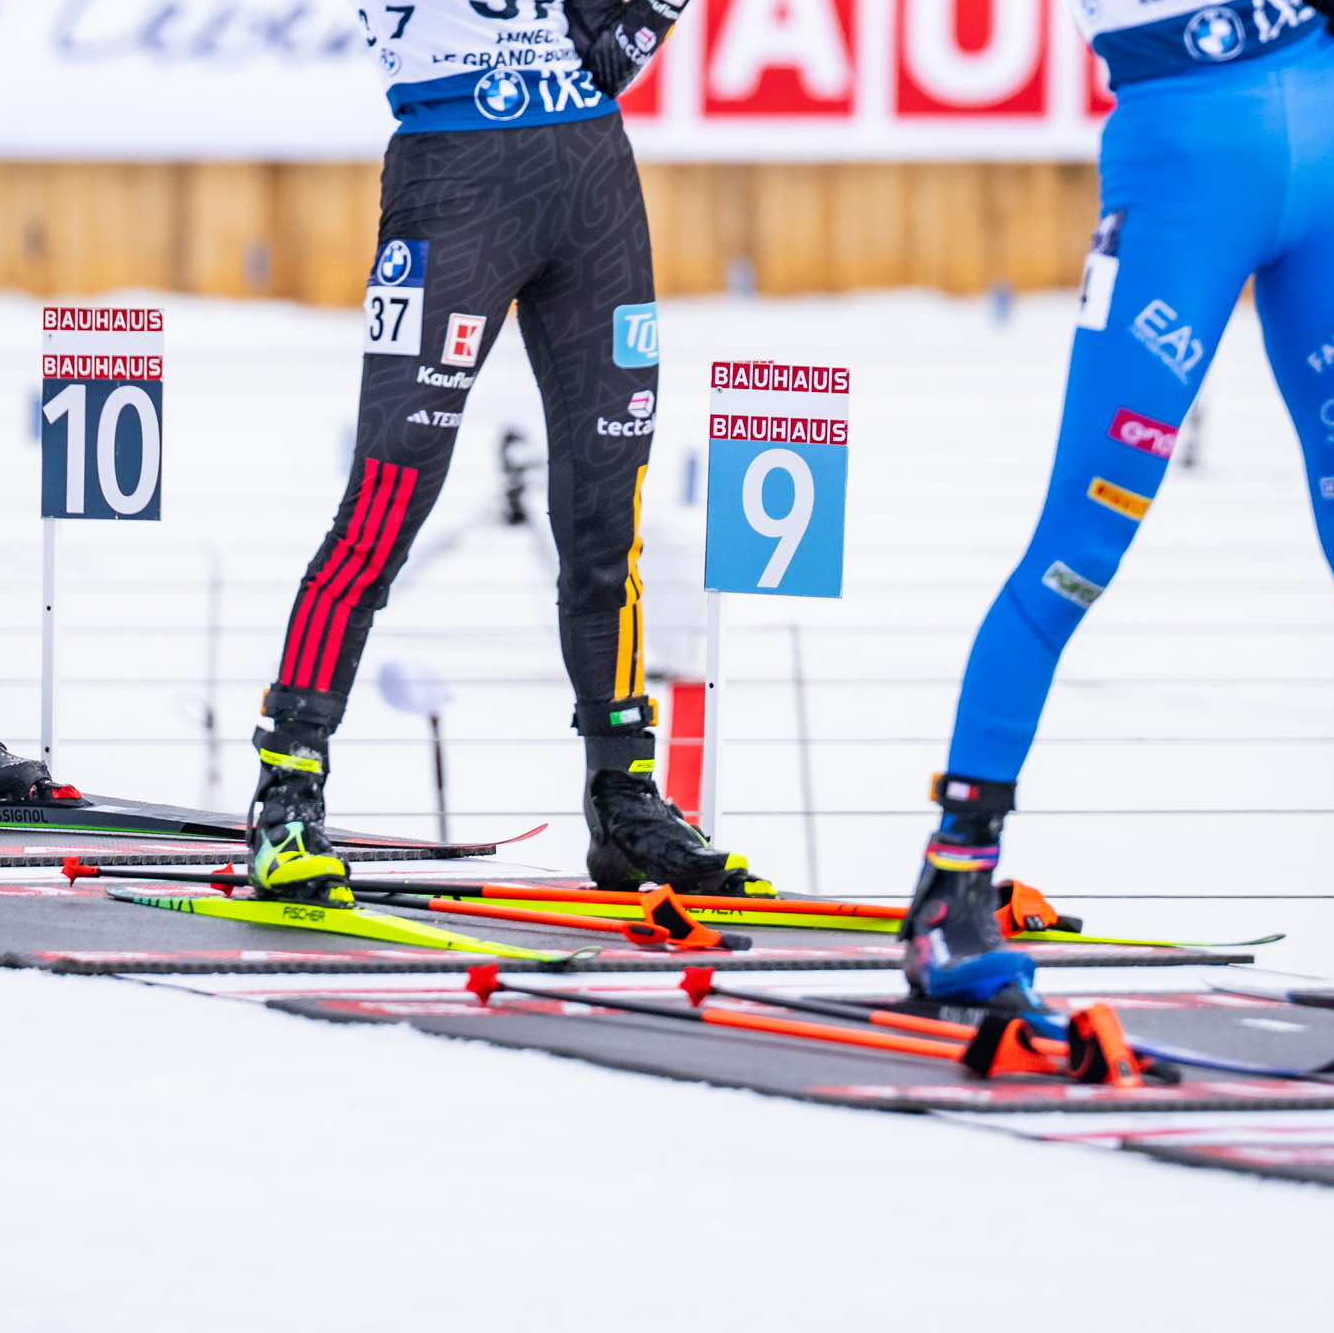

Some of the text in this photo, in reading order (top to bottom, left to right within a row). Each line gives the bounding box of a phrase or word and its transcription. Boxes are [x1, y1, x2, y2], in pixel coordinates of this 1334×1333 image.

[539, 69, 603, 113] iX3
[44, 309, 162, 330] BAUHAUS
[369, 295, 410, 343] 37
[43, 356, 162, 378] BAUHAUS
[714, 365, 849, 391] BAUHAUS
[712, 418, 848, 443] BAUHAUS
[42, 383, 161, 516] 10
[742, 448, 815, 588] 9
[283, 905, 326, 922] FISCHER
